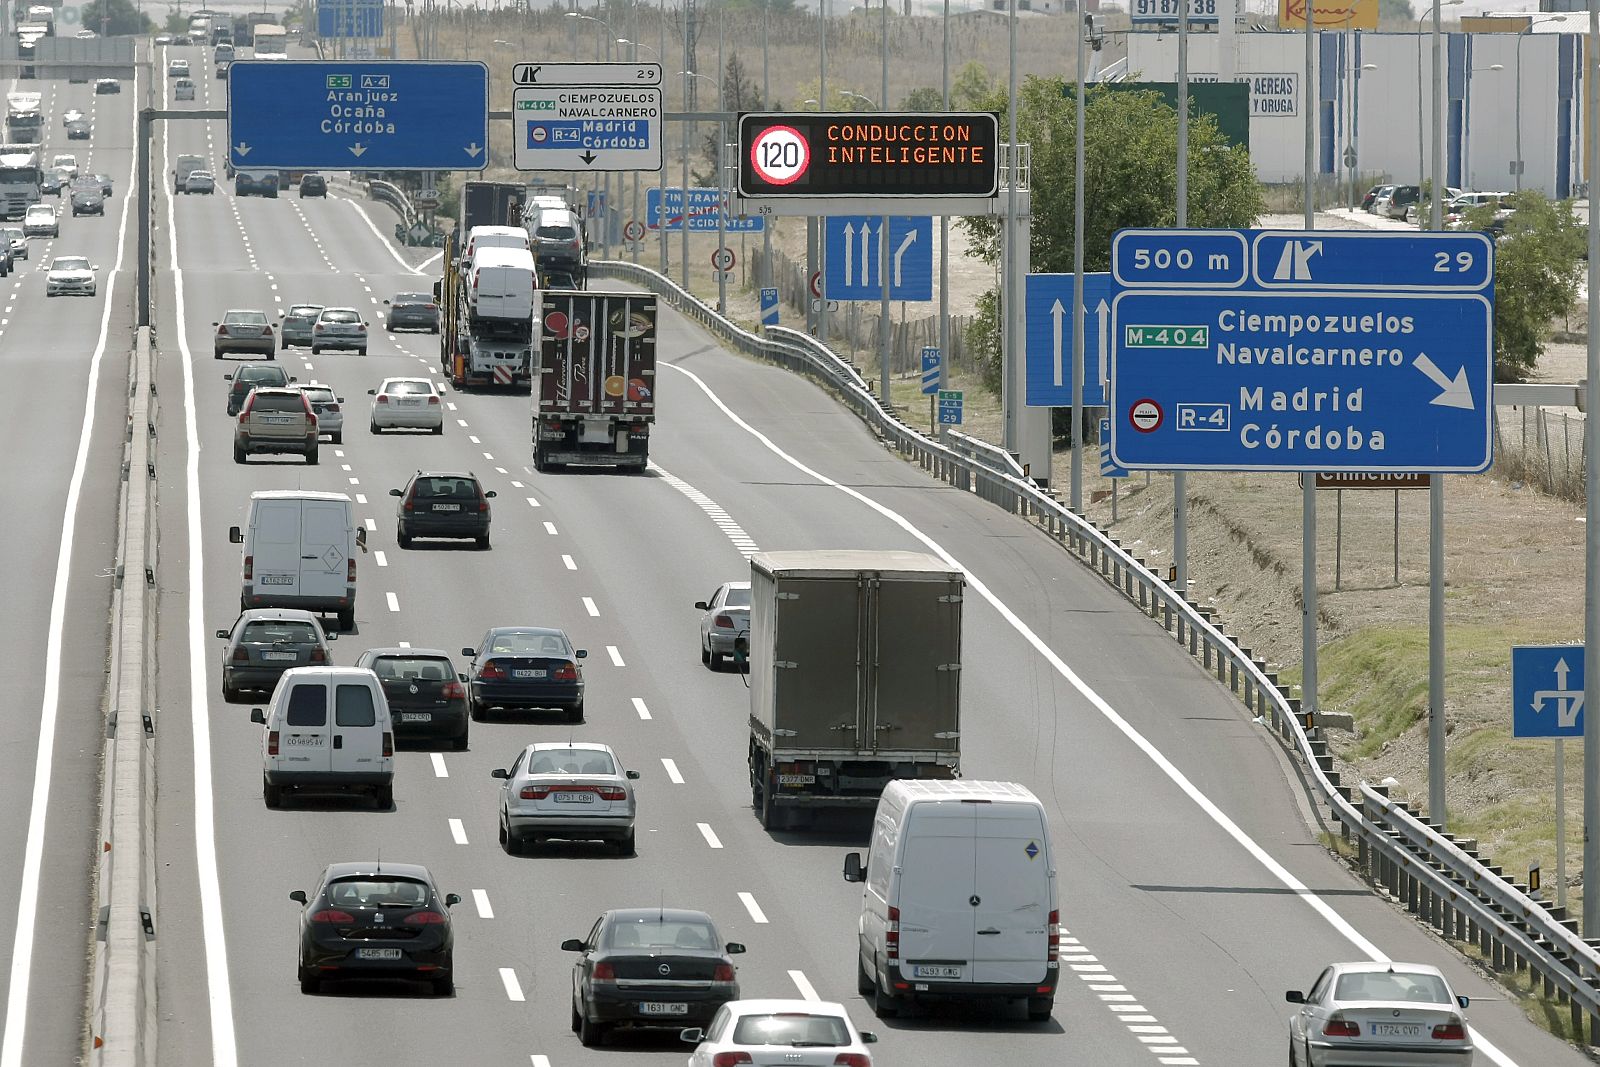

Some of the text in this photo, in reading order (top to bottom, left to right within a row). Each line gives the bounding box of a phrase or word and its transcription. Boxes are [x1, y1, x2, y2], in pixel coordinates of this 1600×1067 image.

[637, 70, 655, 79] 29
[328, 76, 388, 88] E-5 A-4
[1254, 78, 1292, 95] AEREAS
[326, 90, 398, 104] Aranjuez
[559, 94, 654, 103] CIEMPOZUELOS
[330, 104, 385, 118] Ocaña
[517, 101, 555, 110] M-404
[1254, 99, 1294, 112] Y ORUGA
[559, 108, 657, 118] NAVALCARNERO
[320, 119, 396, 134] Córdoba
[582, 121, 636, 132] Madrid
[828, 125, 970, 142] CONDUCCION
[555, 130, 578, 140] R-4
[583, 136, 646, 148] Córdoba
[761, 142, 799, 169] 120
[828, 146, 984, 164] INTELIGENTE
[1134, 249, 1230, 270] 500 m
[1434, 252, 1474, 272] 29
[1218, 309, 1414, 338] Ciempozuelos
[1128, 328, 1206, 346] M-404
[1217, 343, 1404, 366] Navalcarnero
[1240, 386, 1363, 412] Madrid
[944, 414, 958, 422] 29
[1181, 408, 1225, 427] R-4
[1240, 424, 1386, 451] Córdoba
[647, 1003, 664, 1012] 1631
[1380, 1025, 1400, 1034] 1724
